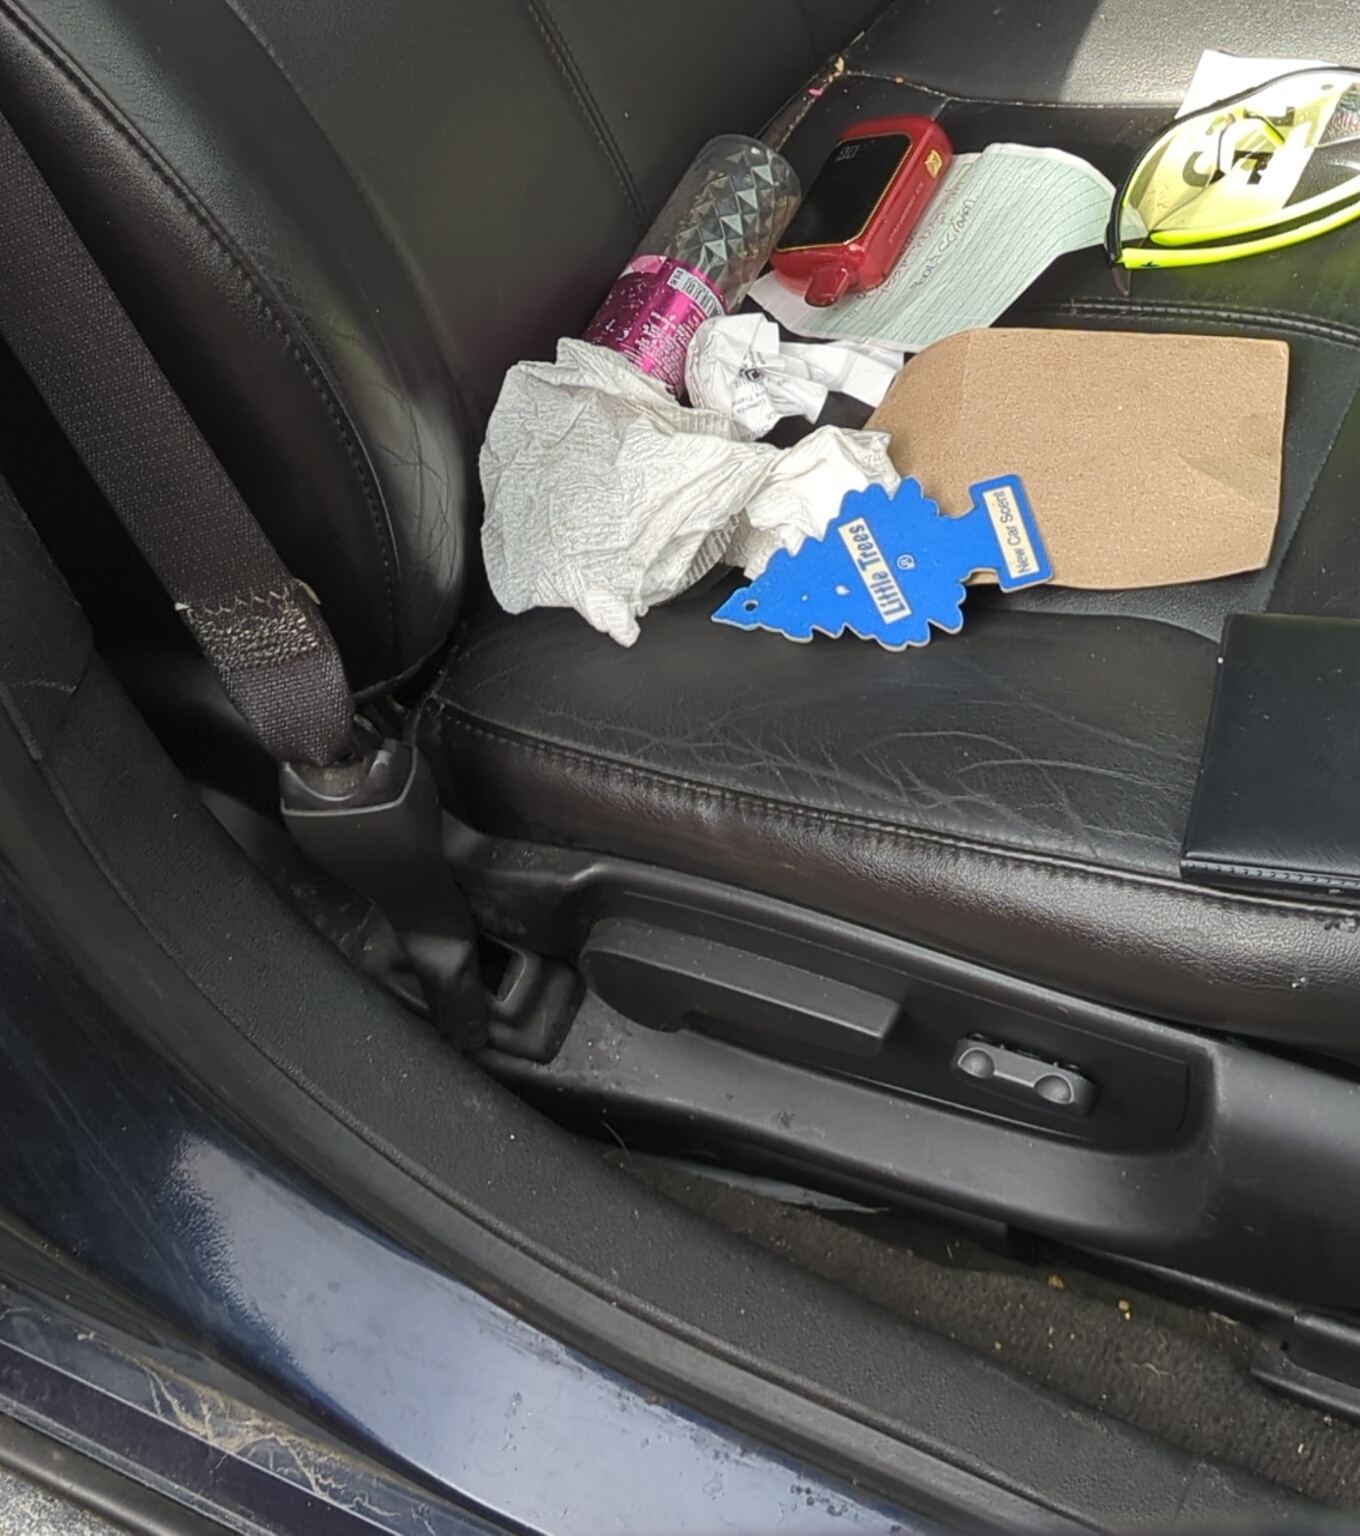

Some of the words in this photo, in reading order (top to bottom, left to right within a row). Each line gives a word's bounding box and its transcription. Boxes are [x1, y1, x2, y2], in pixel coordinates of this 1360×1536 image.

[992, 490, 1014, 524] Scent
[849, 524, 881, 571] Trees
[1006, 525, 1021, 546] Car
[1014, 548, 1031, 573] New
[870, 571, 907, 616] Little
